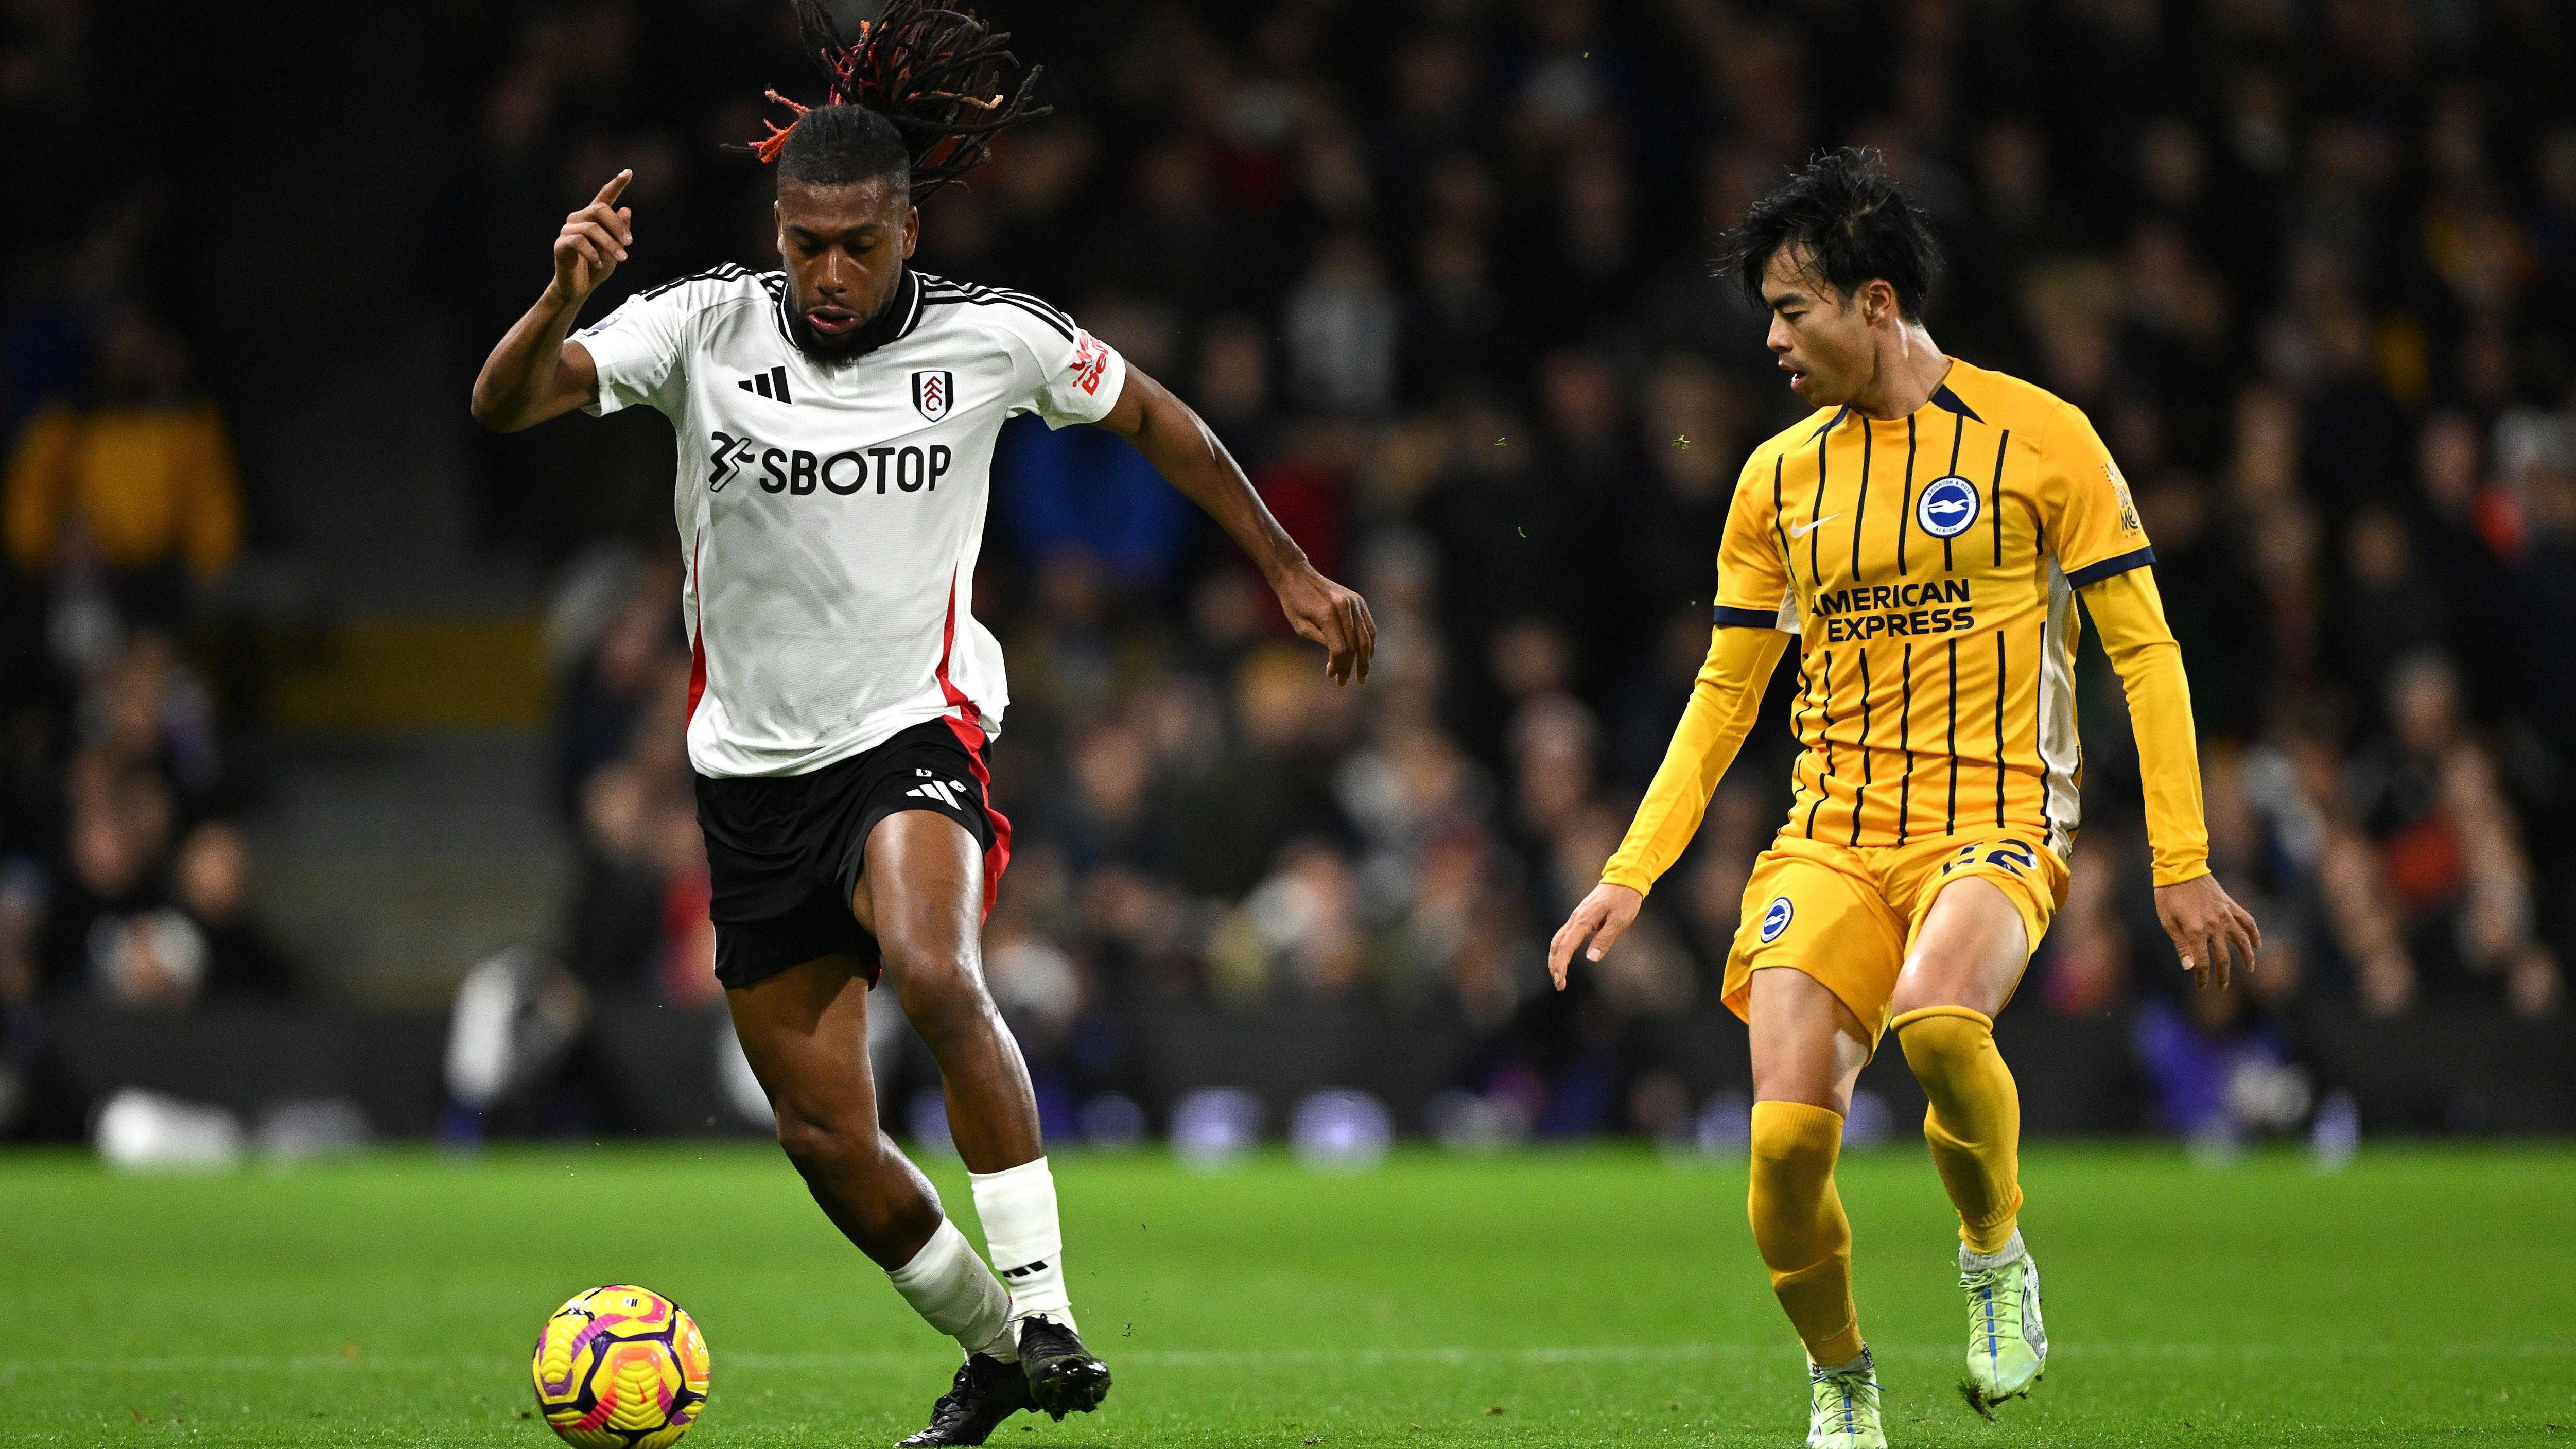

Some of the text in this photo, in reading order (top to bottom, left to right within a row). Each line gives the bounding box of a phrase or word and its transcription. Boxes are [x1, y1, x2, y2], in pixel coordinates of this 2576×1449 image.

[759, 444, 952, 495] SBOTOP
[1927, 480, 1953, 496] BRIGHTON
[1960, 483, 1972, 495] HOVE
[1812, 578, 1970, 617] AMERICAN
[1828, 607, 1975, 642] EXPRESS
